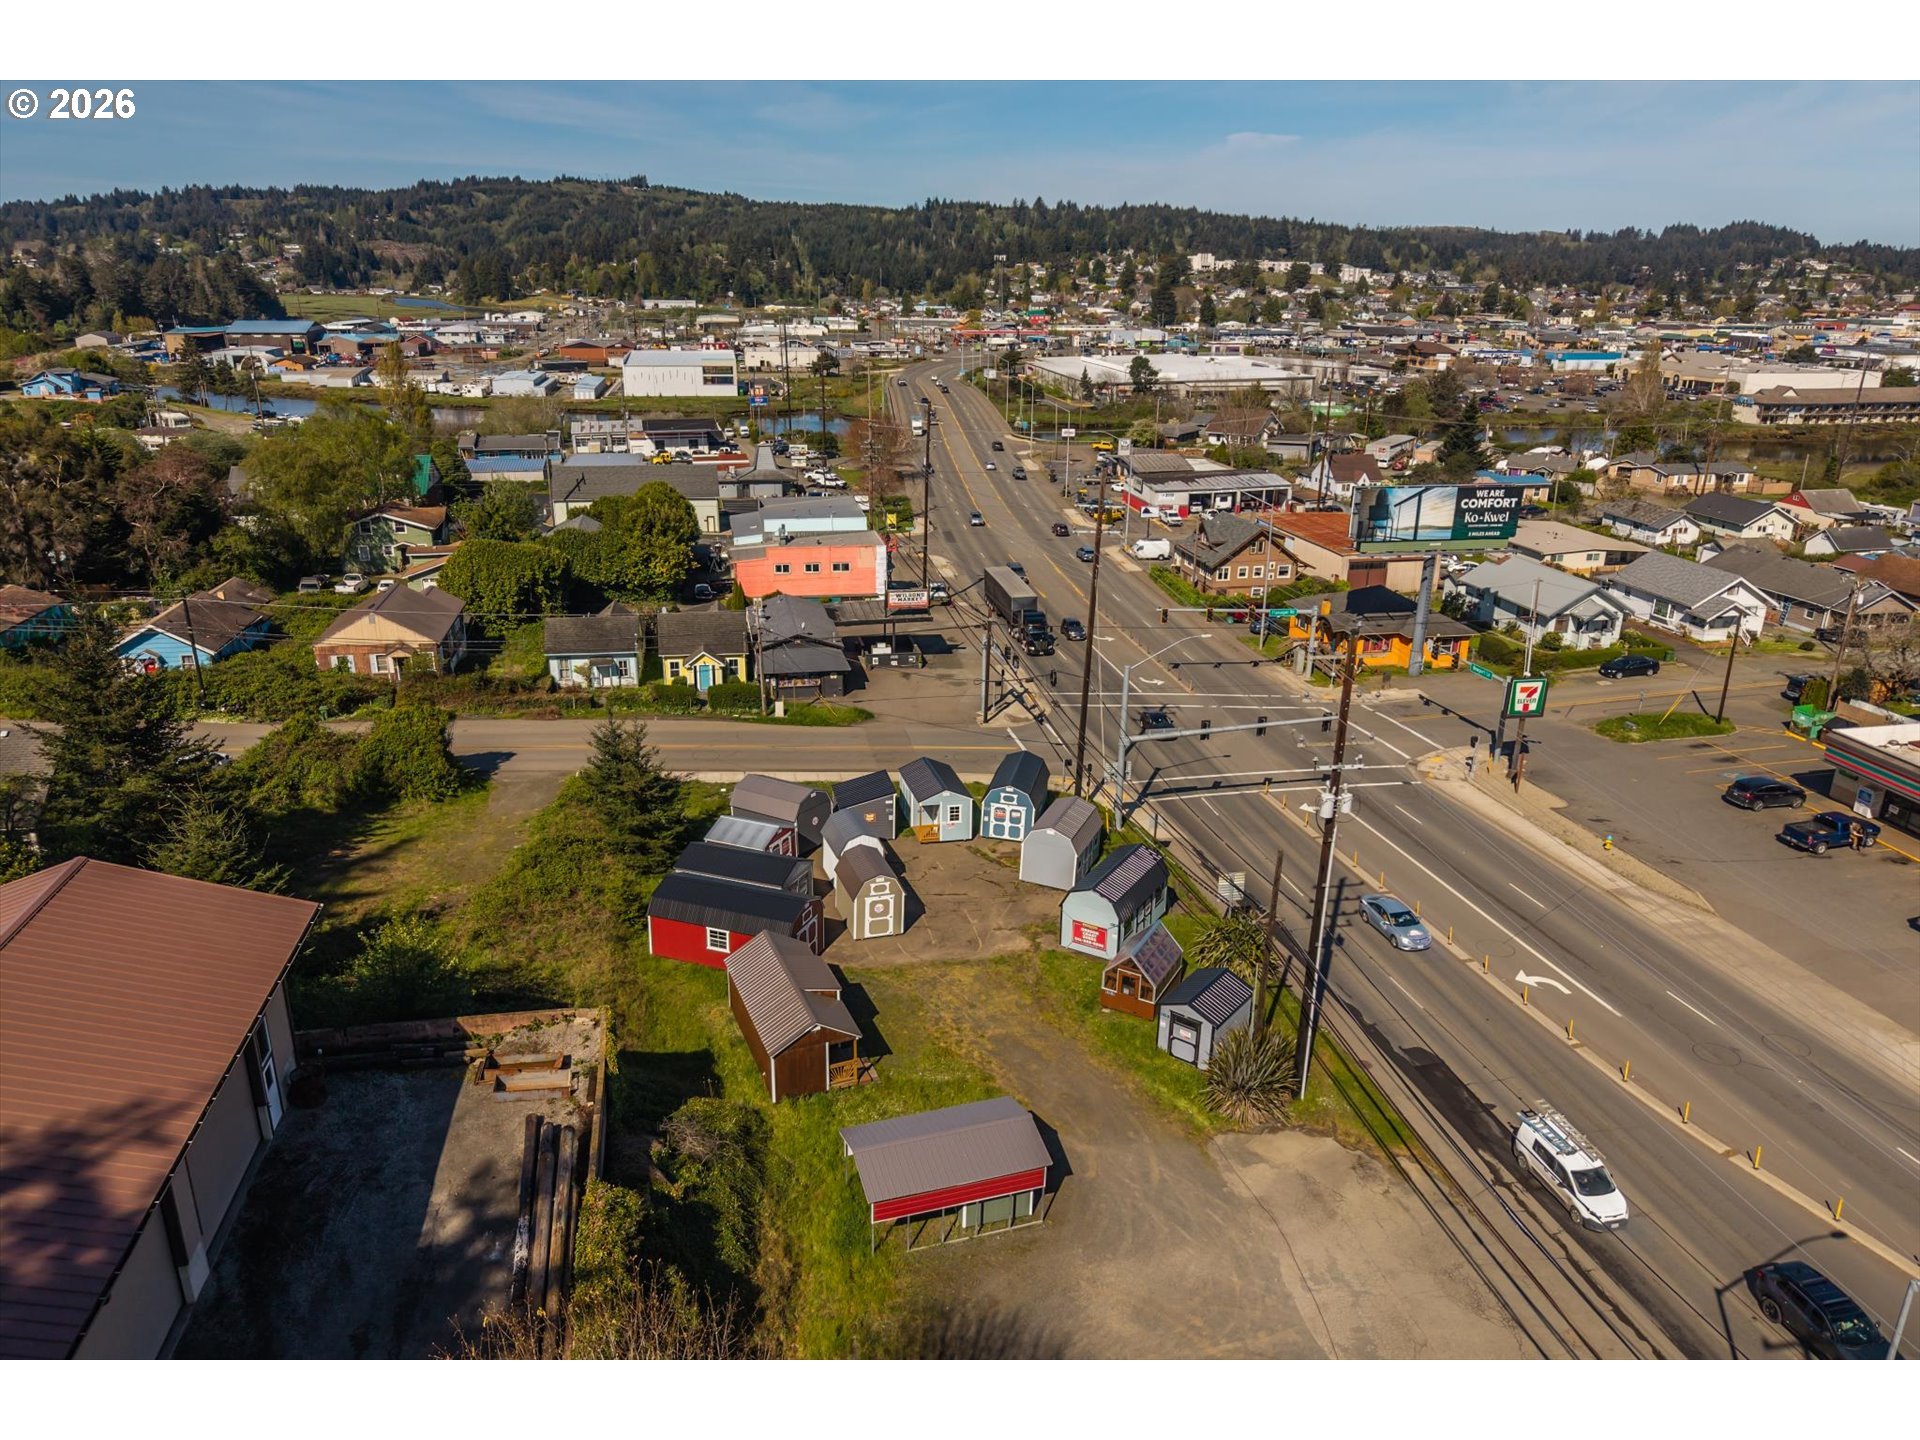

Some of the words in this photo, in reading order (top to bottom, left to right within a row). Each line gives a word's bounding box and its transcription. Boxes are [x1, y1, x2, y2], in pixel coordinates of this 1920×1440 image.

[1476, 490, 1489, 498] WE
[1490, 489, 1505, 497] ARE
[1461, 498, 1518, 509] COMFORT
[1464, 511, 1509, 523] Ko-Kwel
[1519, 686, 1539, 712] 7
